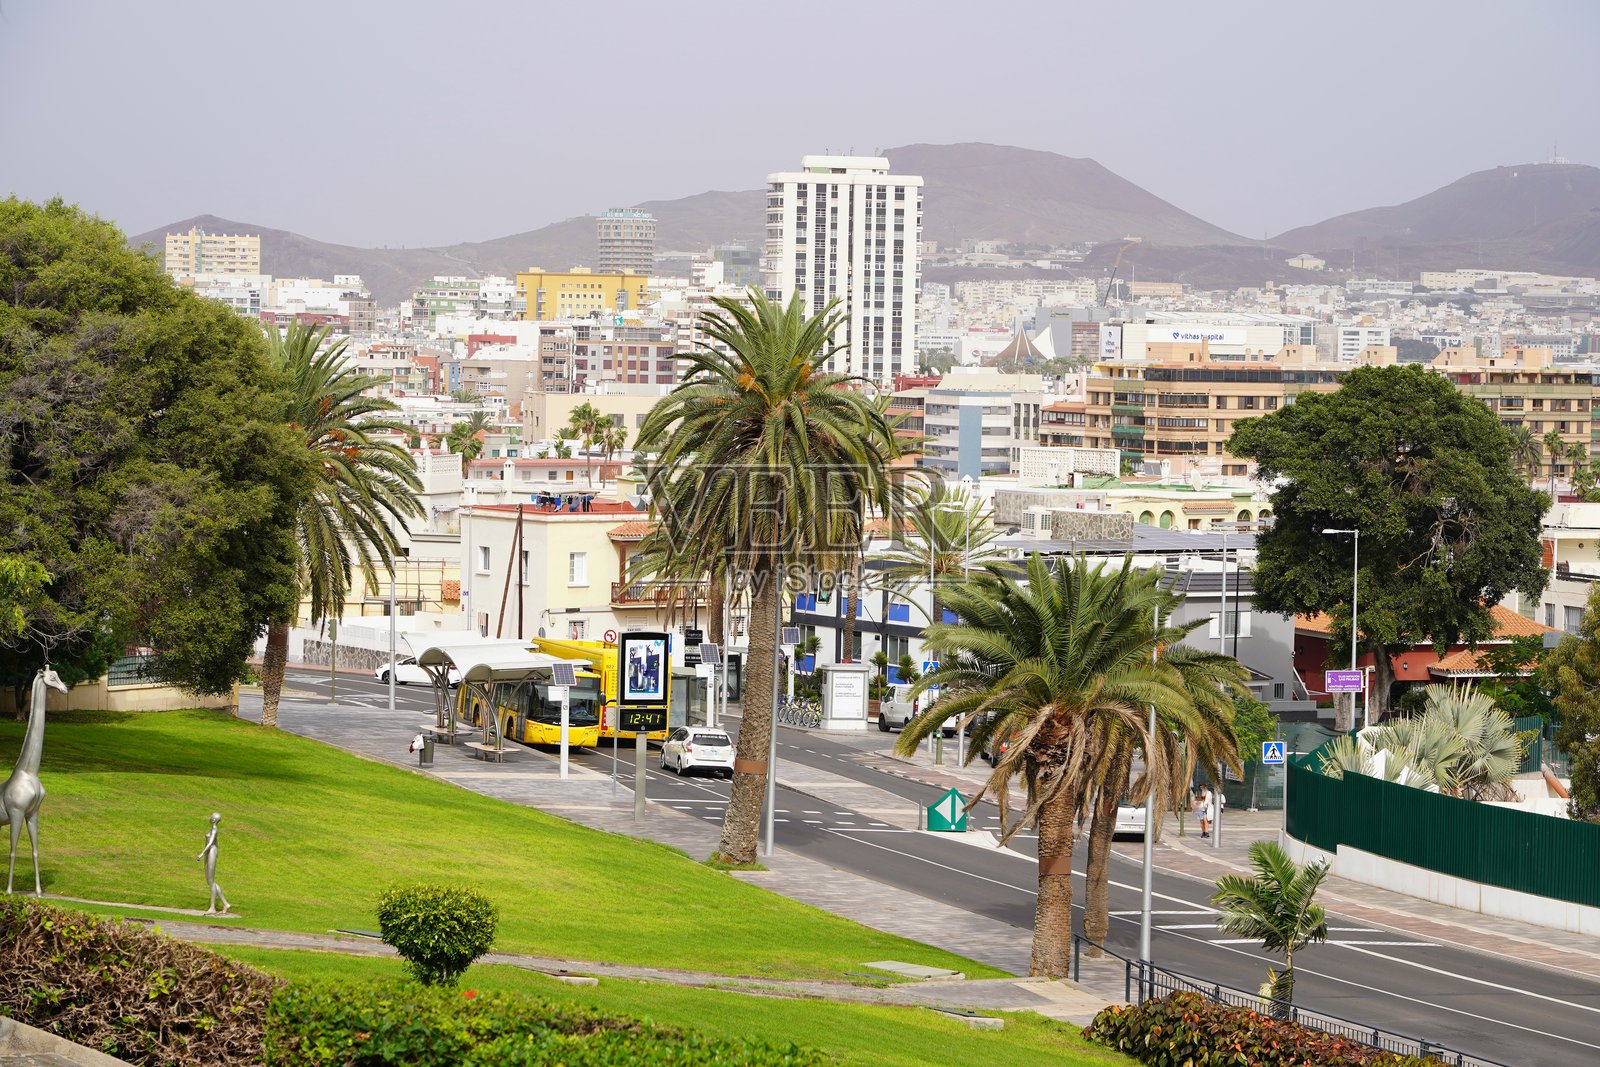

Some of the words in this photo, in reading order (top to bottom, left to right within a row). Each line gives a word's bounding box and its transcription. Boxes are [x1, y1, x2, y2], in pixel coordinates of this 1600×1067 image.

[1180, 333, 1200, 341] vithas
[1200, 333, 1224, 341] hspital
[629, 713, 661, 724] 12:41
